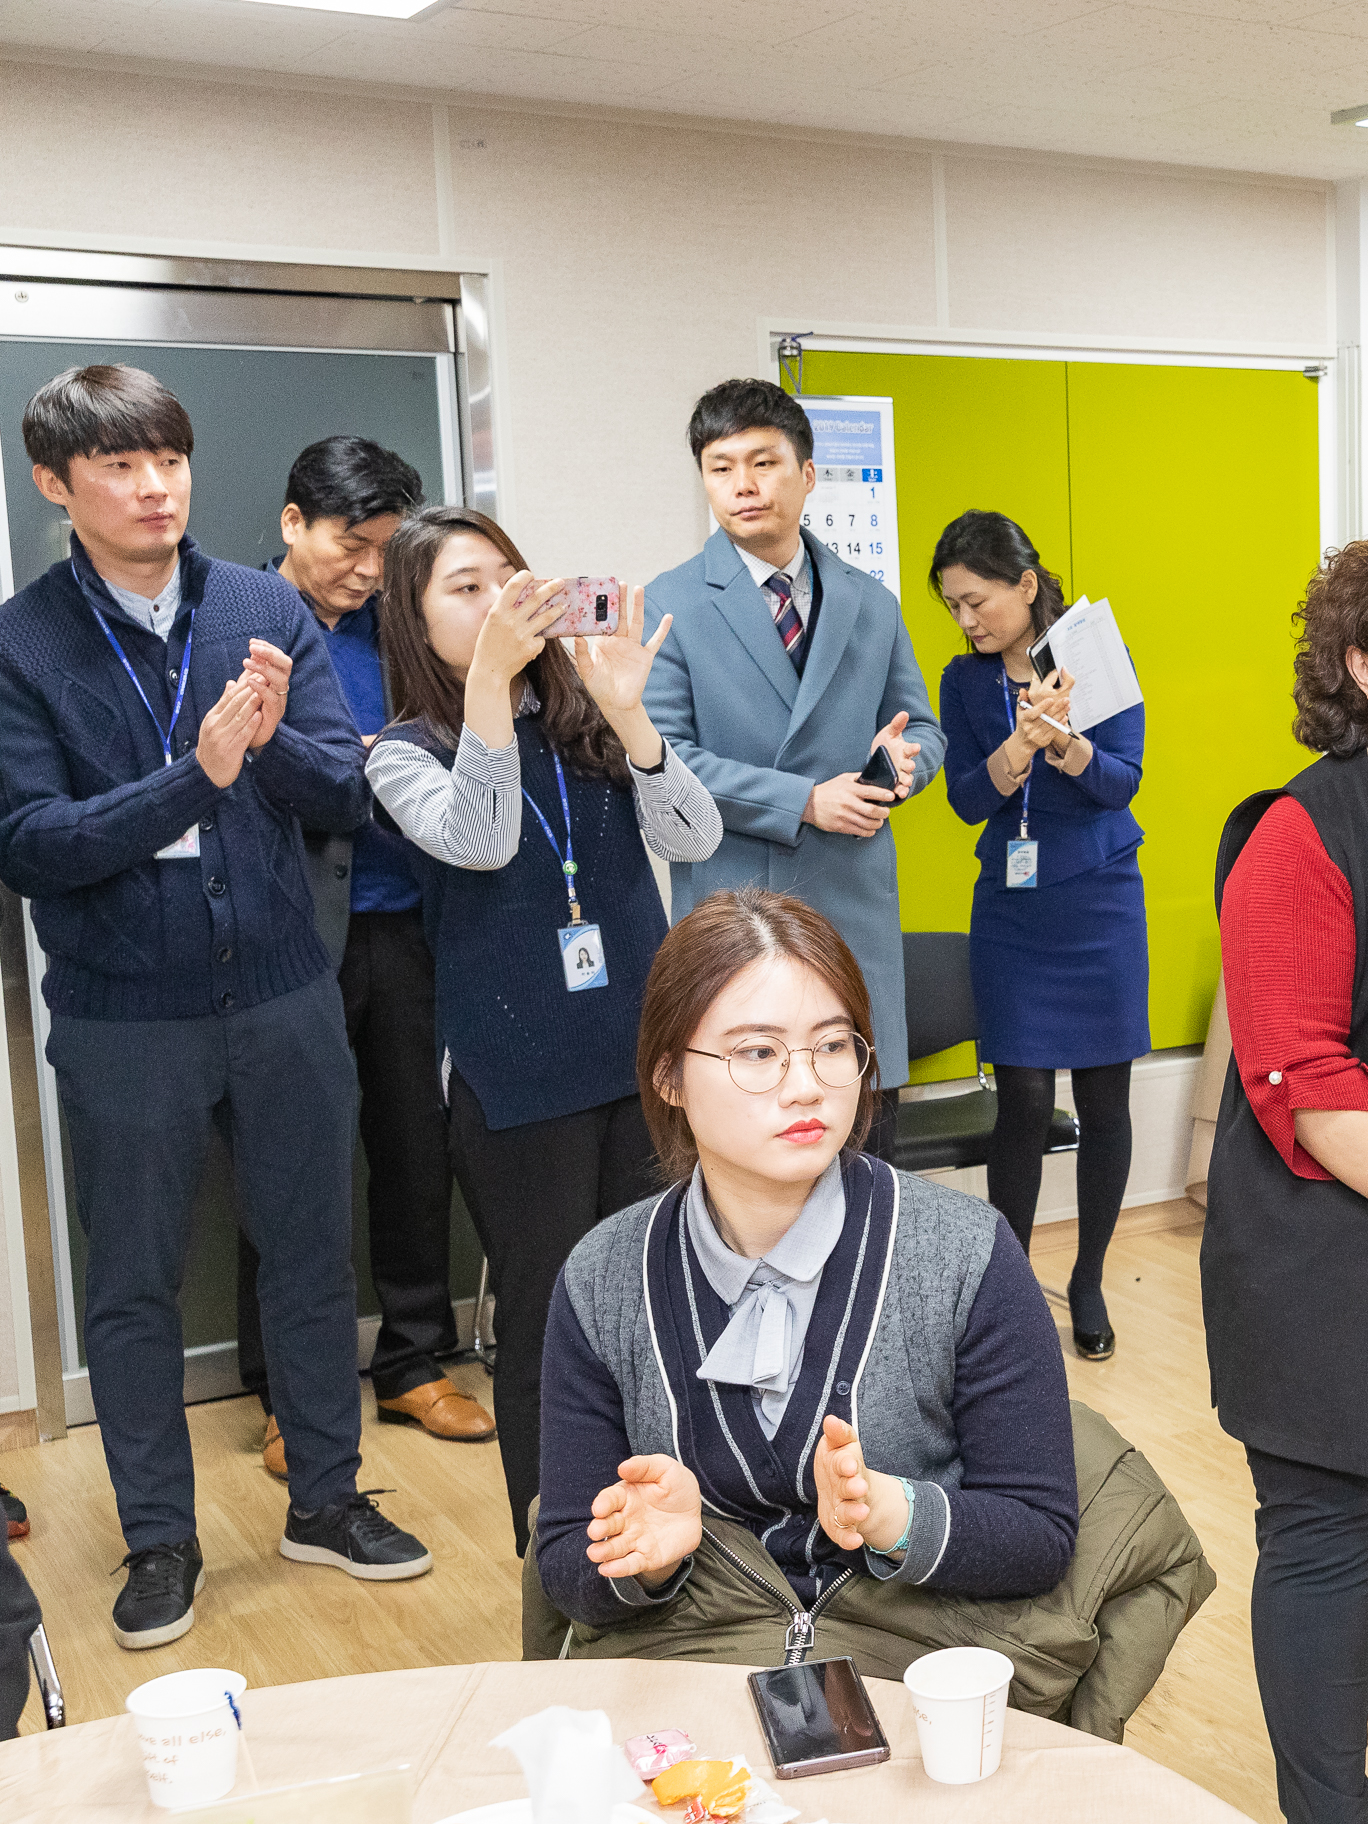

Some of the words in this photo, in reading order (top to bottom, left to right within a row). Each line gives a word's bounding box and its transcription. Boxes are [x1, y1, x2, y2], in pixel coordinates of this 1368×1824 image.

[870, 486, 876, 499] 1
[803, 513, 811, 527] 5
[825, 513, 834, 527] 6
[848, 513, 856, 527] 7
[870, 513, 878, 527] 8
[847, 542, 861, 555] 14
[869, 542, 884, 555] 15
[161, 1735, 182, 1747] all
